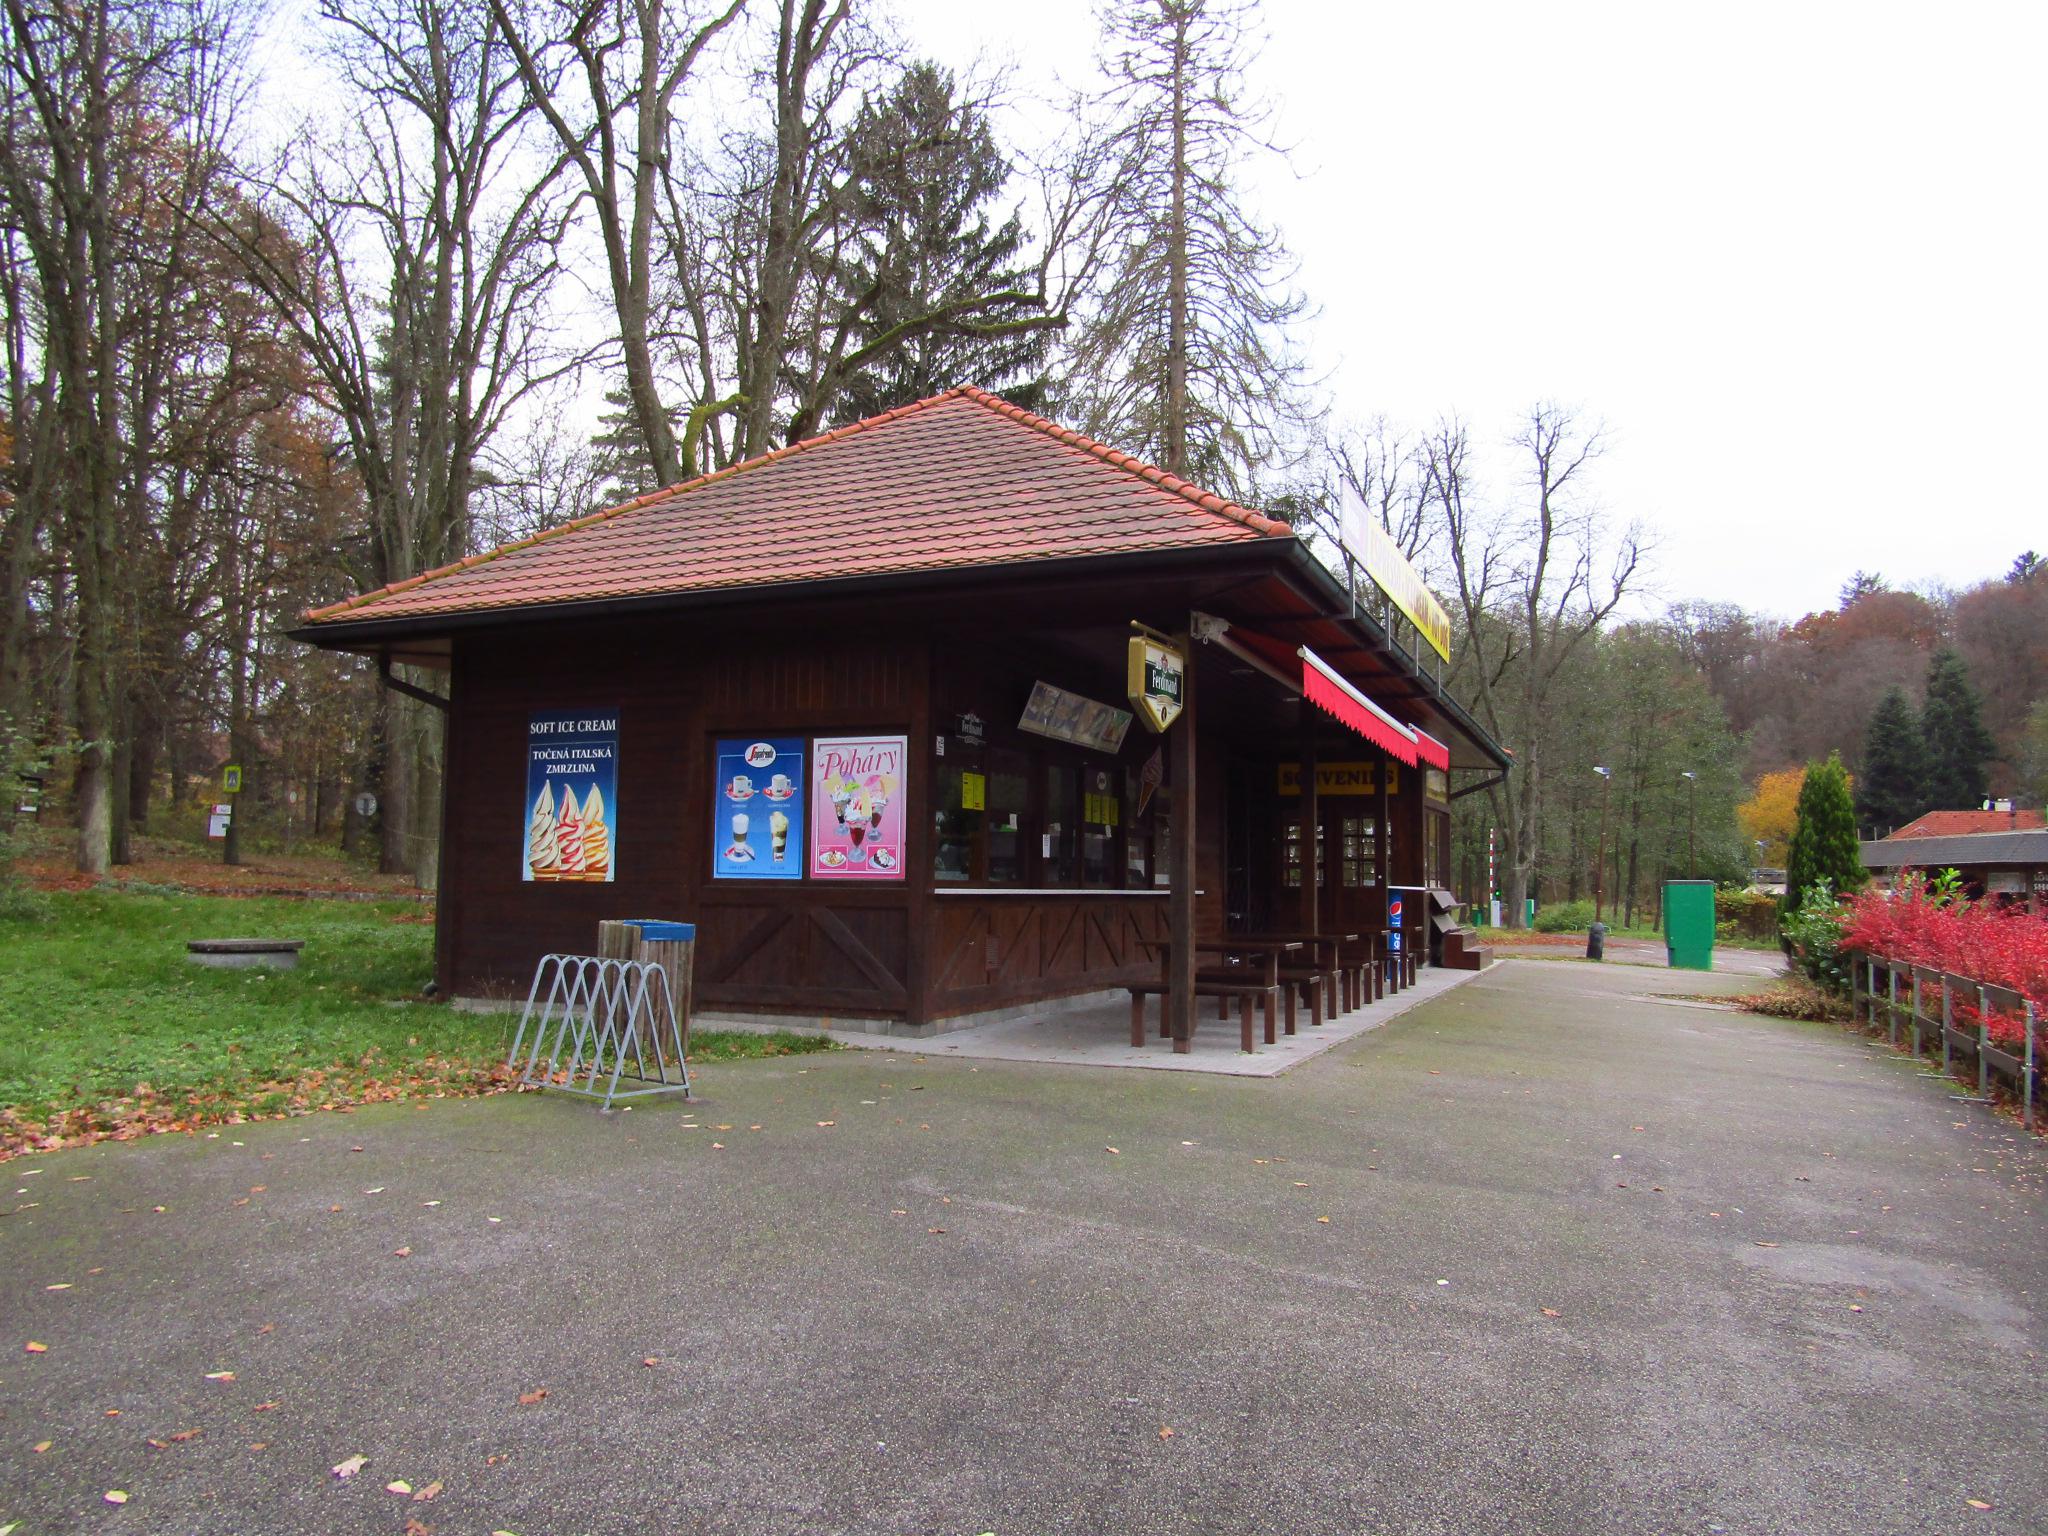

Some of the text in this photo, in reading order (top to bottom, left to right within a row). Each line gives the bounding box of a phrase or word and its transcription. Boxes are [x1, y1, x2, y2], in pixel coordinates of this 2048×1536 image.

[1152, 669, 1178, 695] Ferdinand
[530, 719, 616, 735] SOFT ICE CREAM
[533, 745, 612, 760] TOČENÁ ITALSKÁ
[546, 763, 596, 774] ZMRZLINA
[818, 746, 897, 780] Poháry
[1282, 769, 1394, 787] SOVENIS
